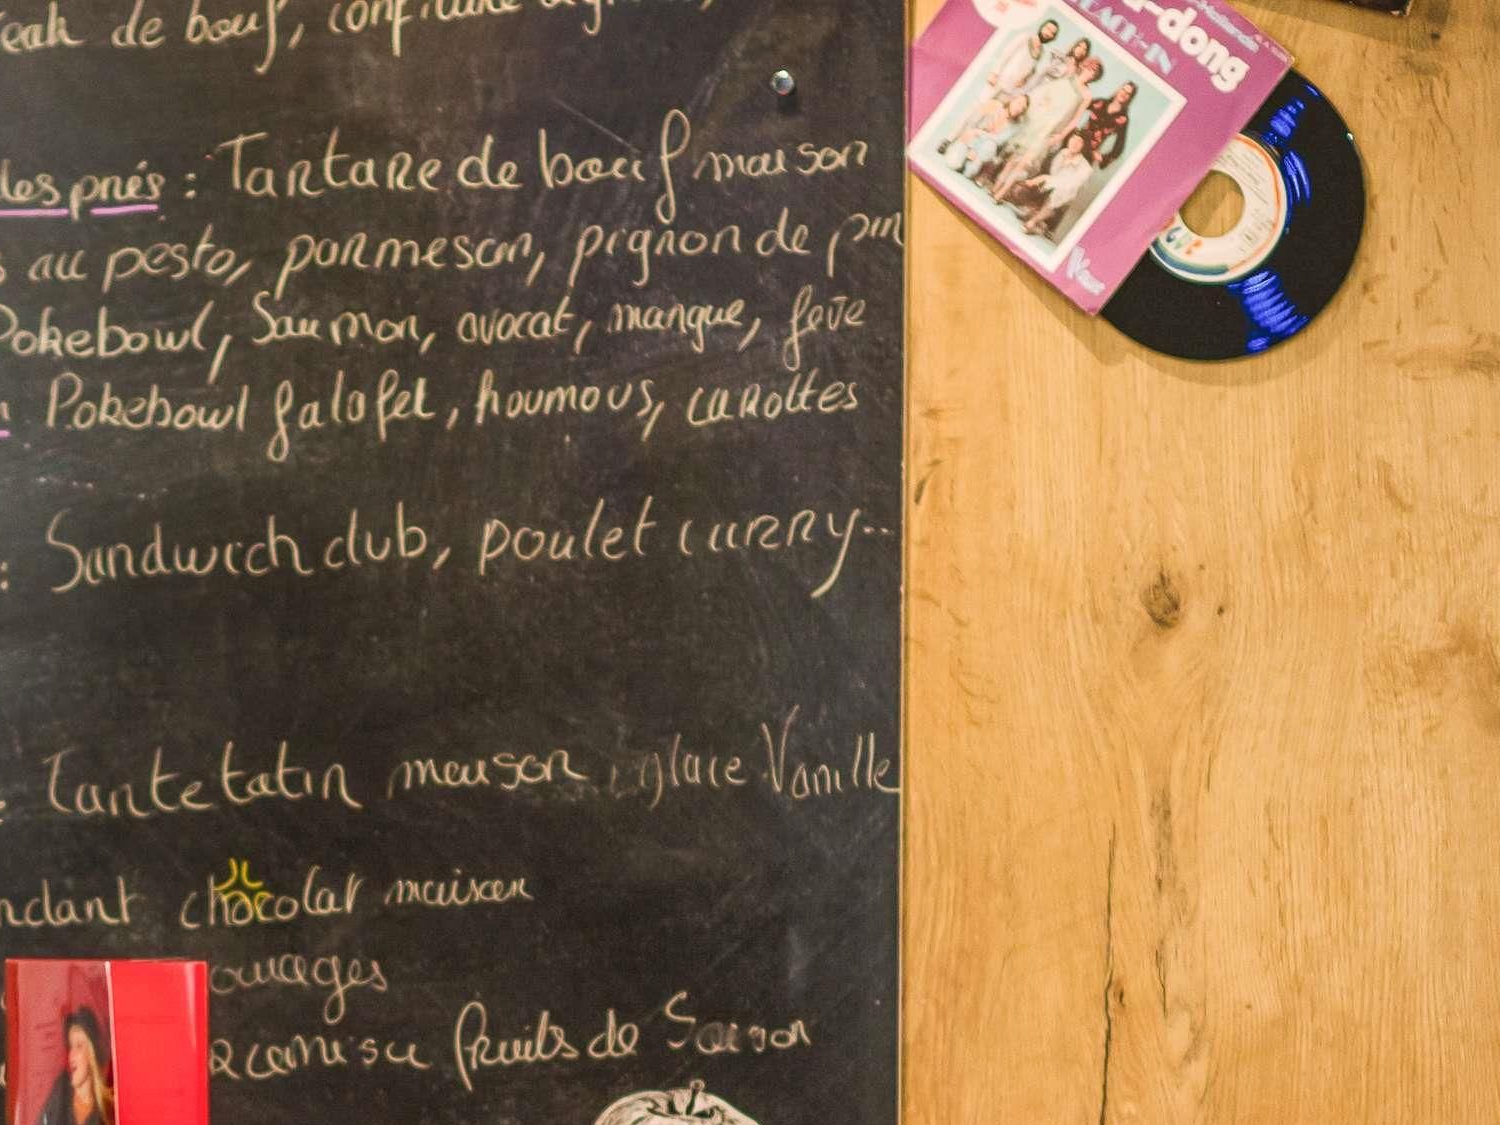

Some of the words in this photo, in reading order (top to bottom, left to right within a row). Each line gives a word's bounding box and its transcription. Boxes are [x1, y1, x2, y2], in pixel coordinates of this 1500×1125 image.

[110, 0, 165, 49] de
[456, 134, 524, 190] de
[693, 140, 868, 183] maison
[28, 247, 89, 282] au
[568, 222, 742, 288] pignon
[755, 207, 811, 258] de
[45, 508, 314, 595] Sandwich
[324, 500, 452, 570] club,
[479, 494, 658, 577] poulet
[586, 1007, 640, 1057] de
